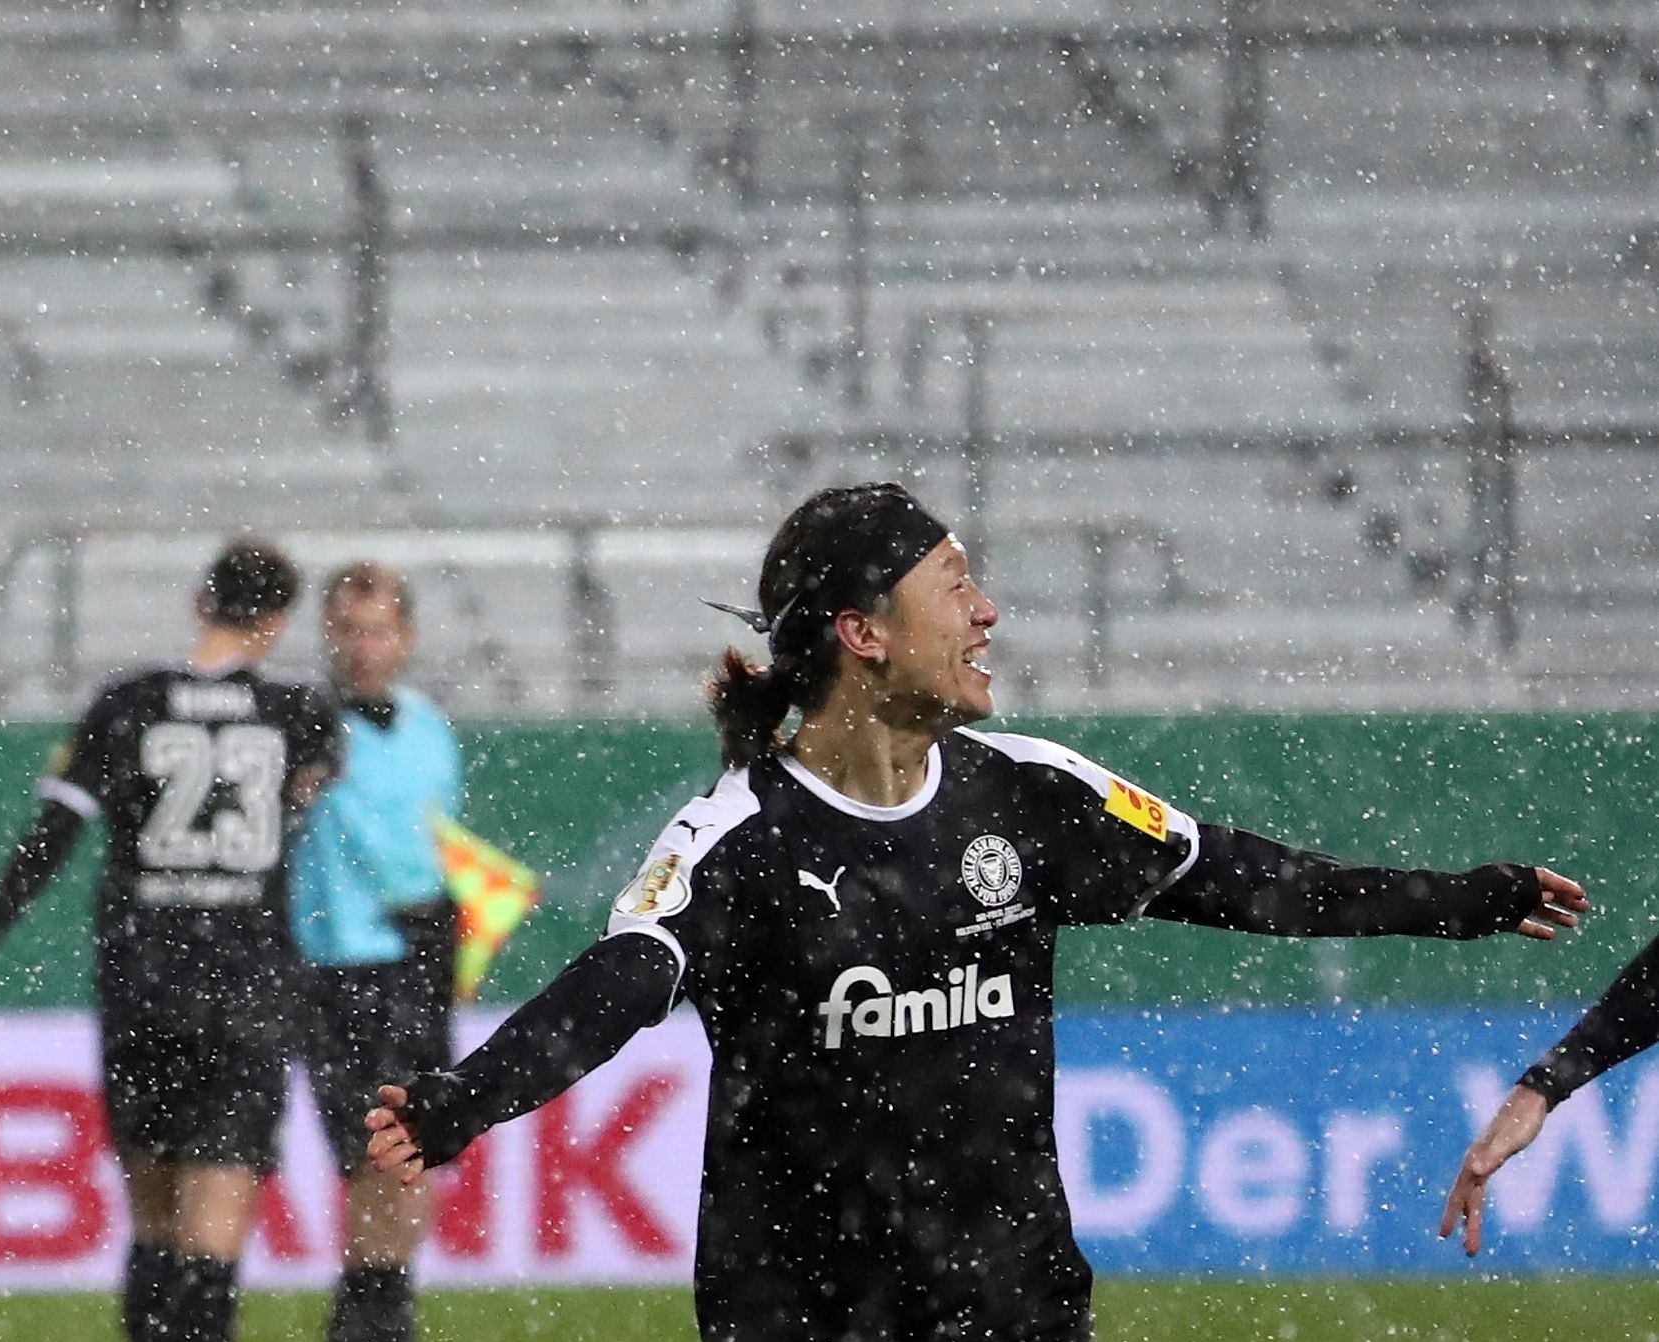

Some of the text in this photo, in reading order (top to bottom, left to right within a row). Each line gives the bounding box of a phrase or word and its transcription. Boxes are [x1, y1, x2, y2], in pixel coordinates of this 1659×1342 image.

[137, 722, 287, 872] 23
[818, 963, 1016, 1050] famila
[1052, 1067, 1404, 1237] Der
